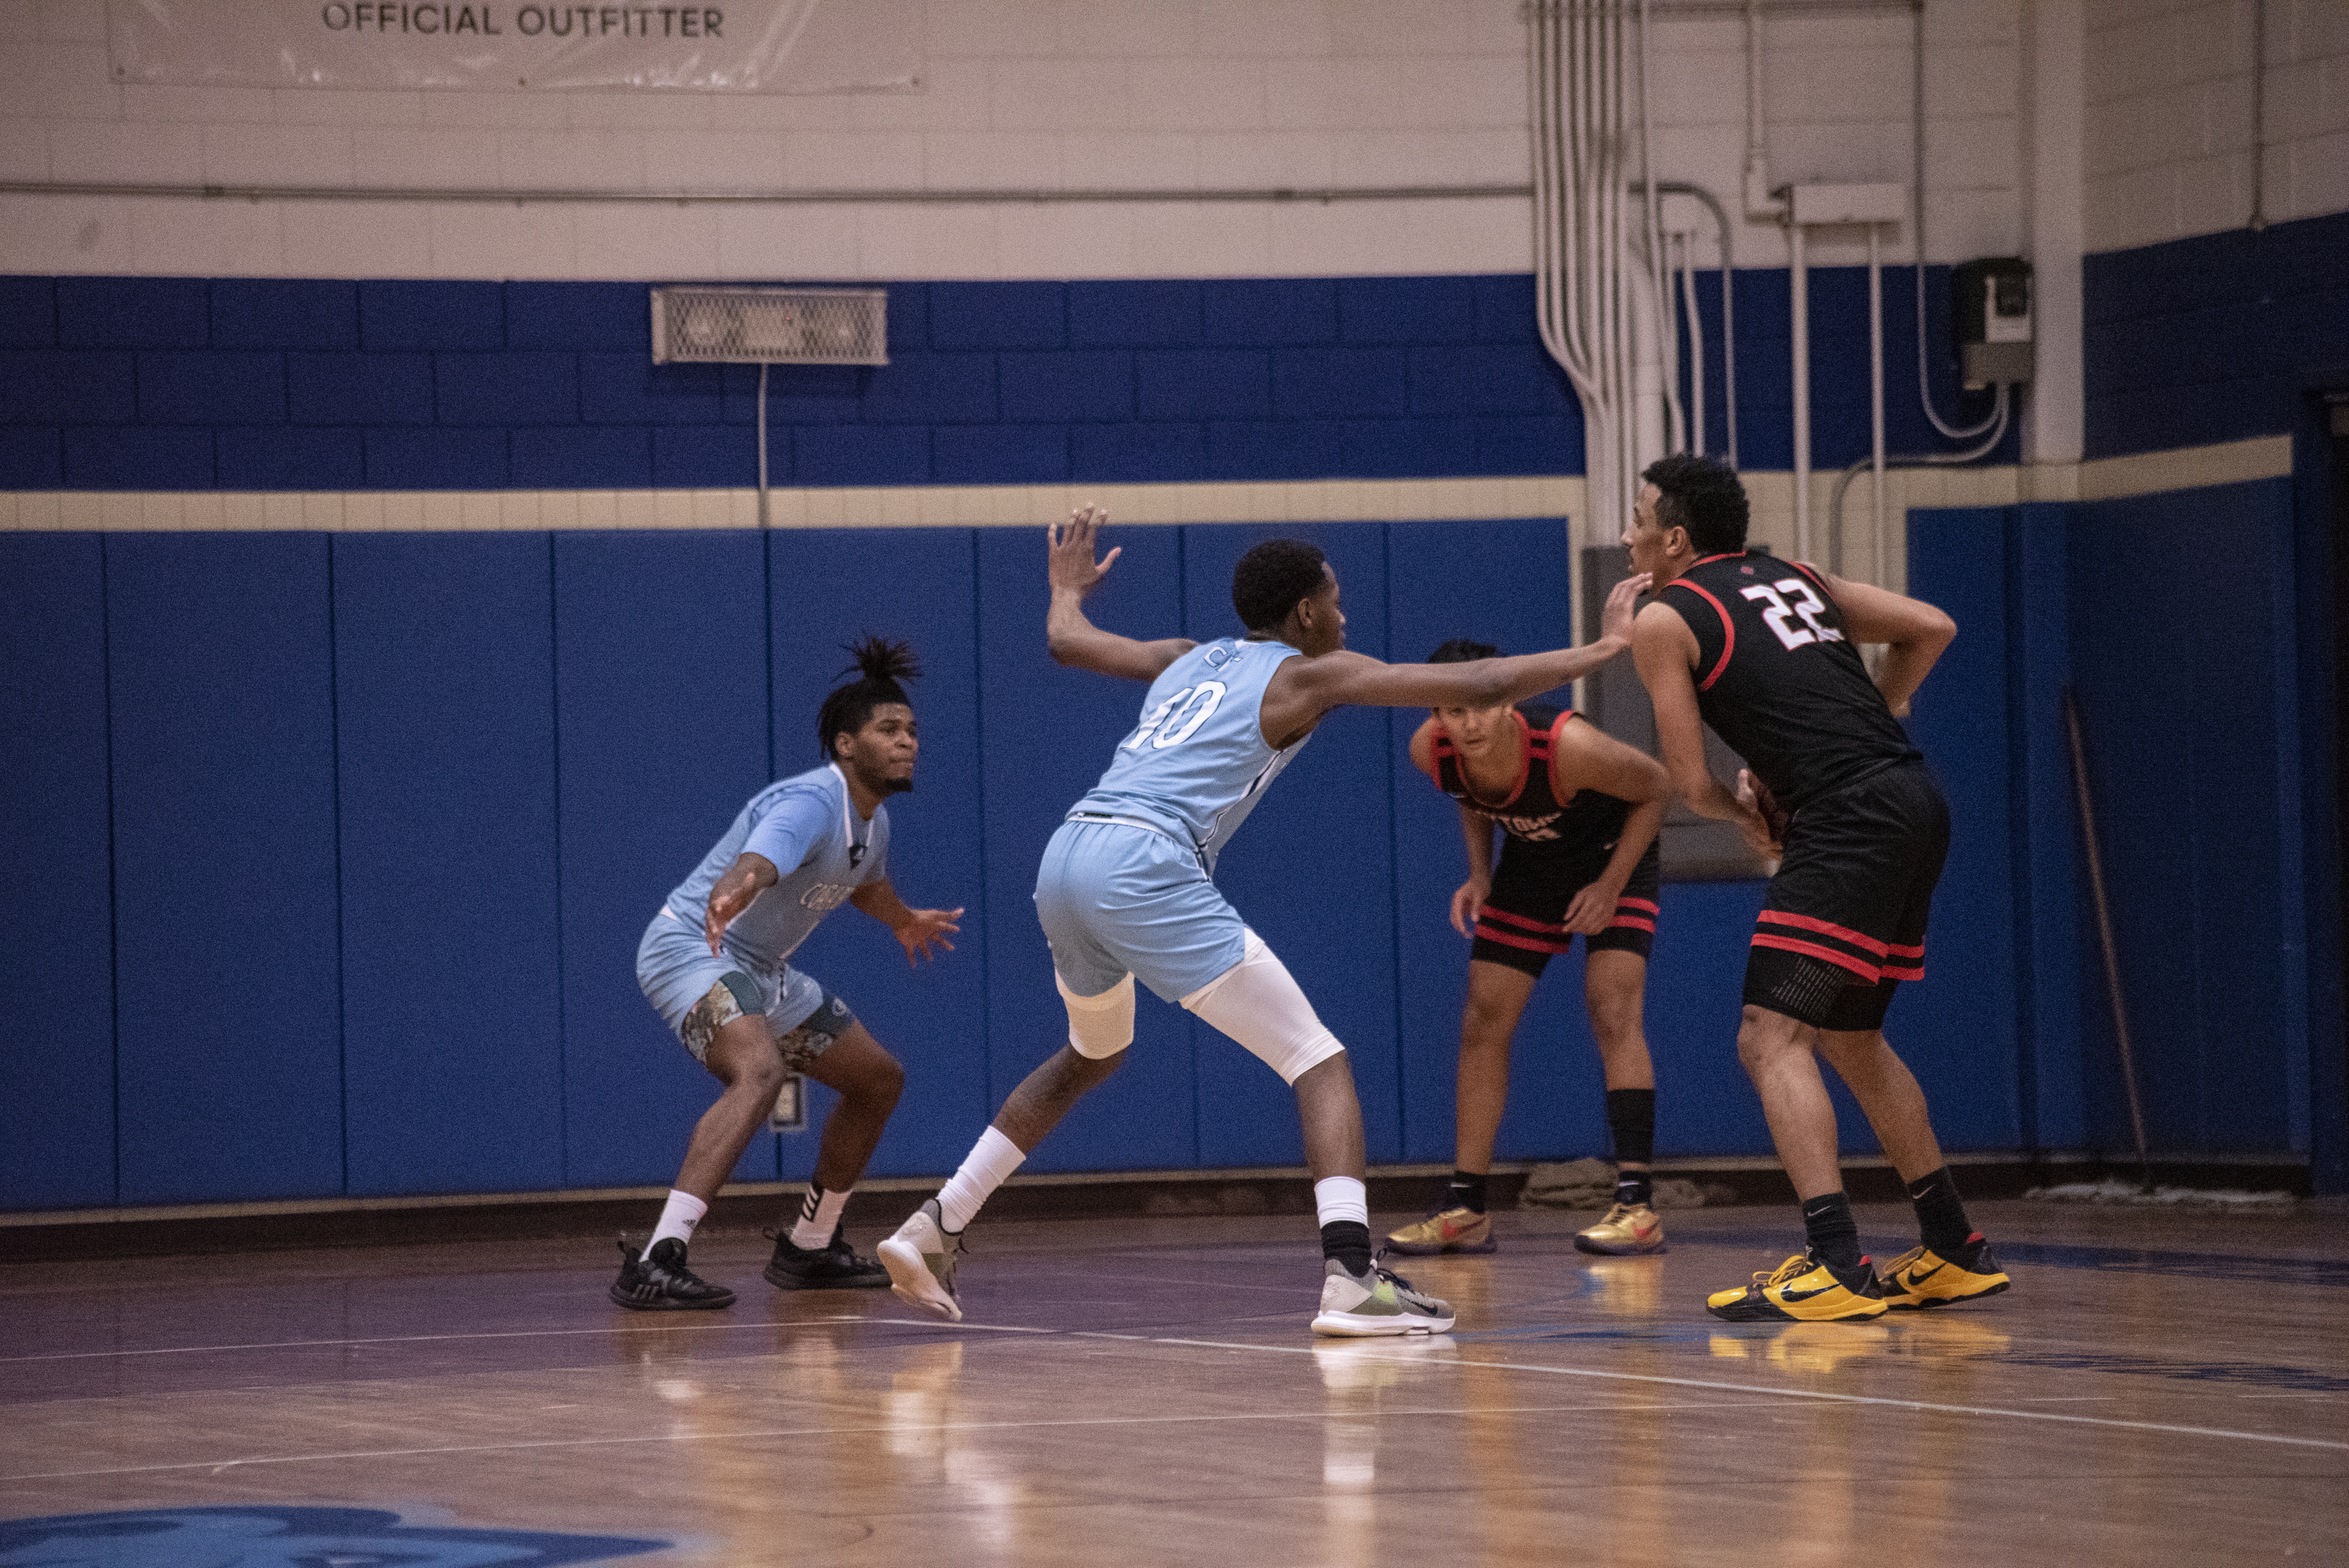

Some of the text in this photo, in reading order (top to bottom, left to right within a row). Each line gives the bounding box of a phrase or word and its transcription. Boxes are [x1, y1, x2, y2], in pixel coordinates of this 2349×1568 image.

[322, 3, 723, 38] OFFICIAL OUTFITTER
[1739, 578, 1844, 651] 22
[1120, 680, 1227, 749] 10
